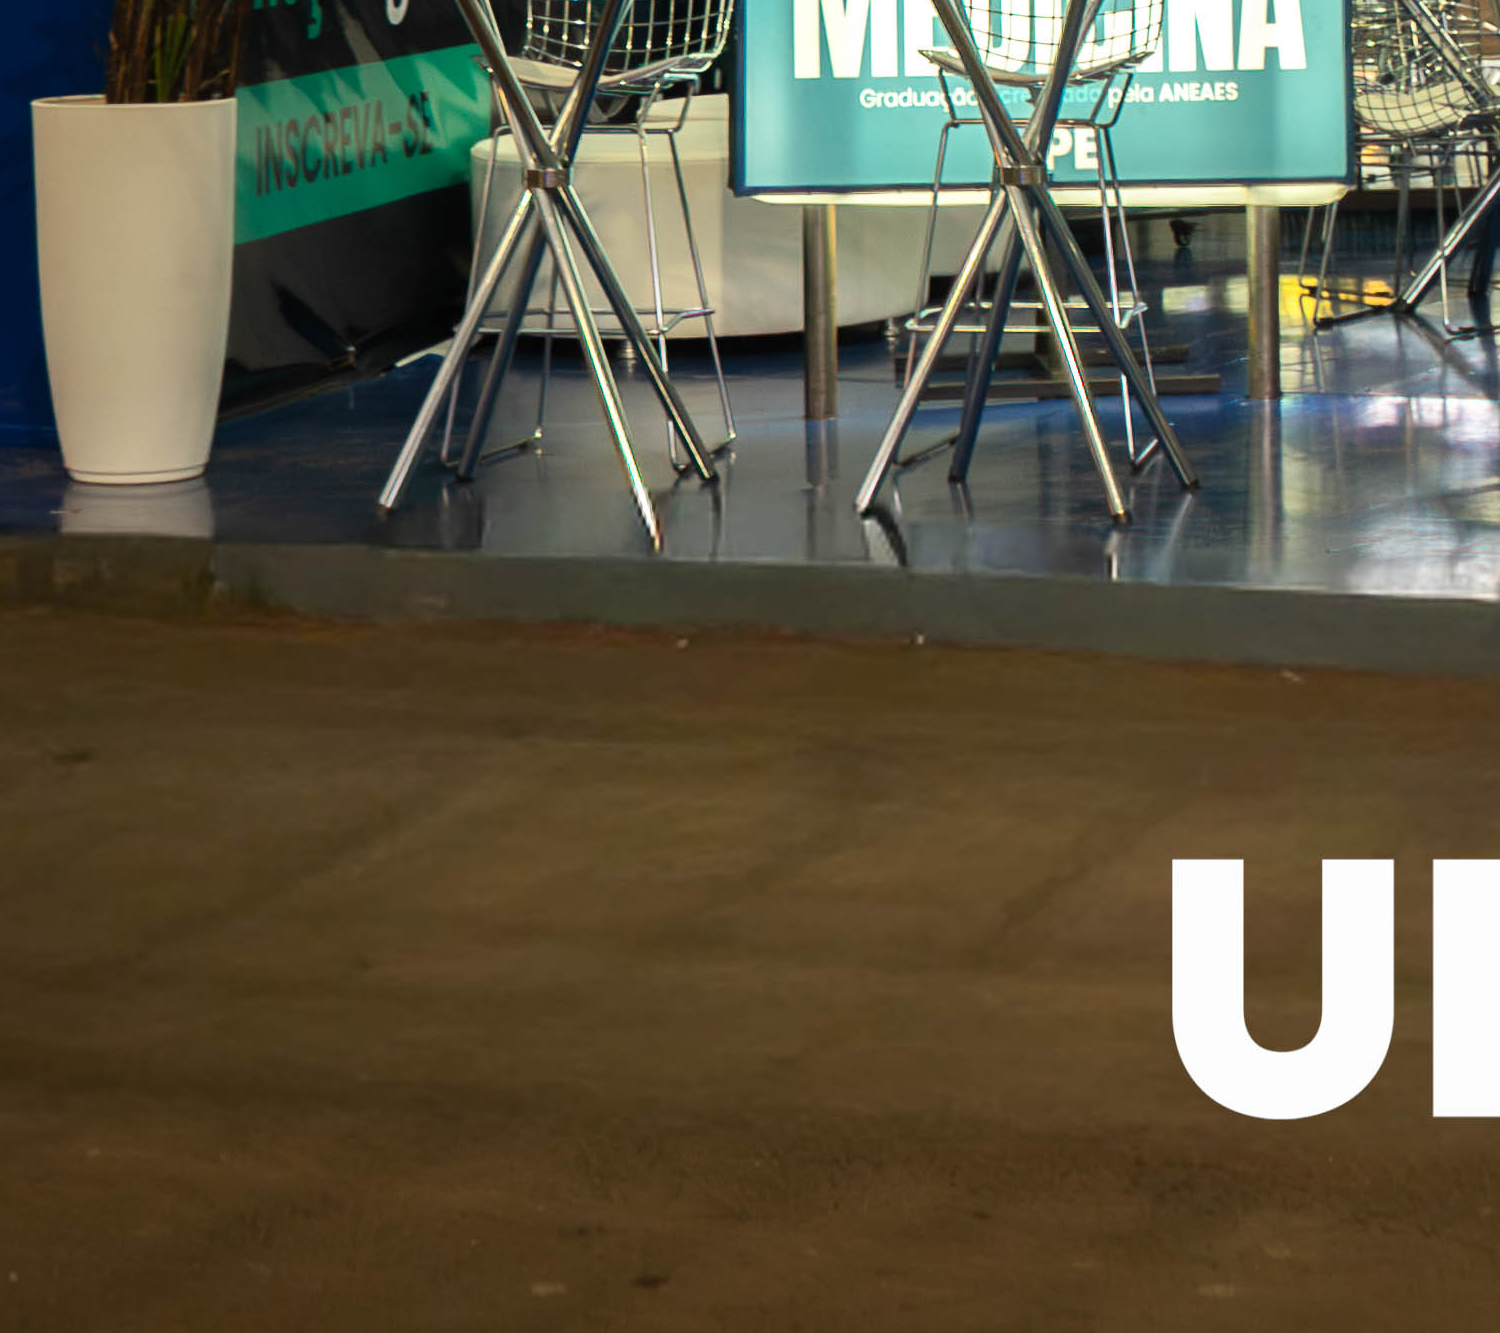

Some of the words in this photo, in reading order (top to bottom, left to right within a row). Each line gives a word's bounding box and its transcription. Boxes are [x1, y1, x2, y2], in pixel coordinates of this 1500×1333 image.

[859, 88, 978, 113] Graduação
[1106, 85, 1155, 108] pela
[1158, 82, 1239, 102] ANEAES
